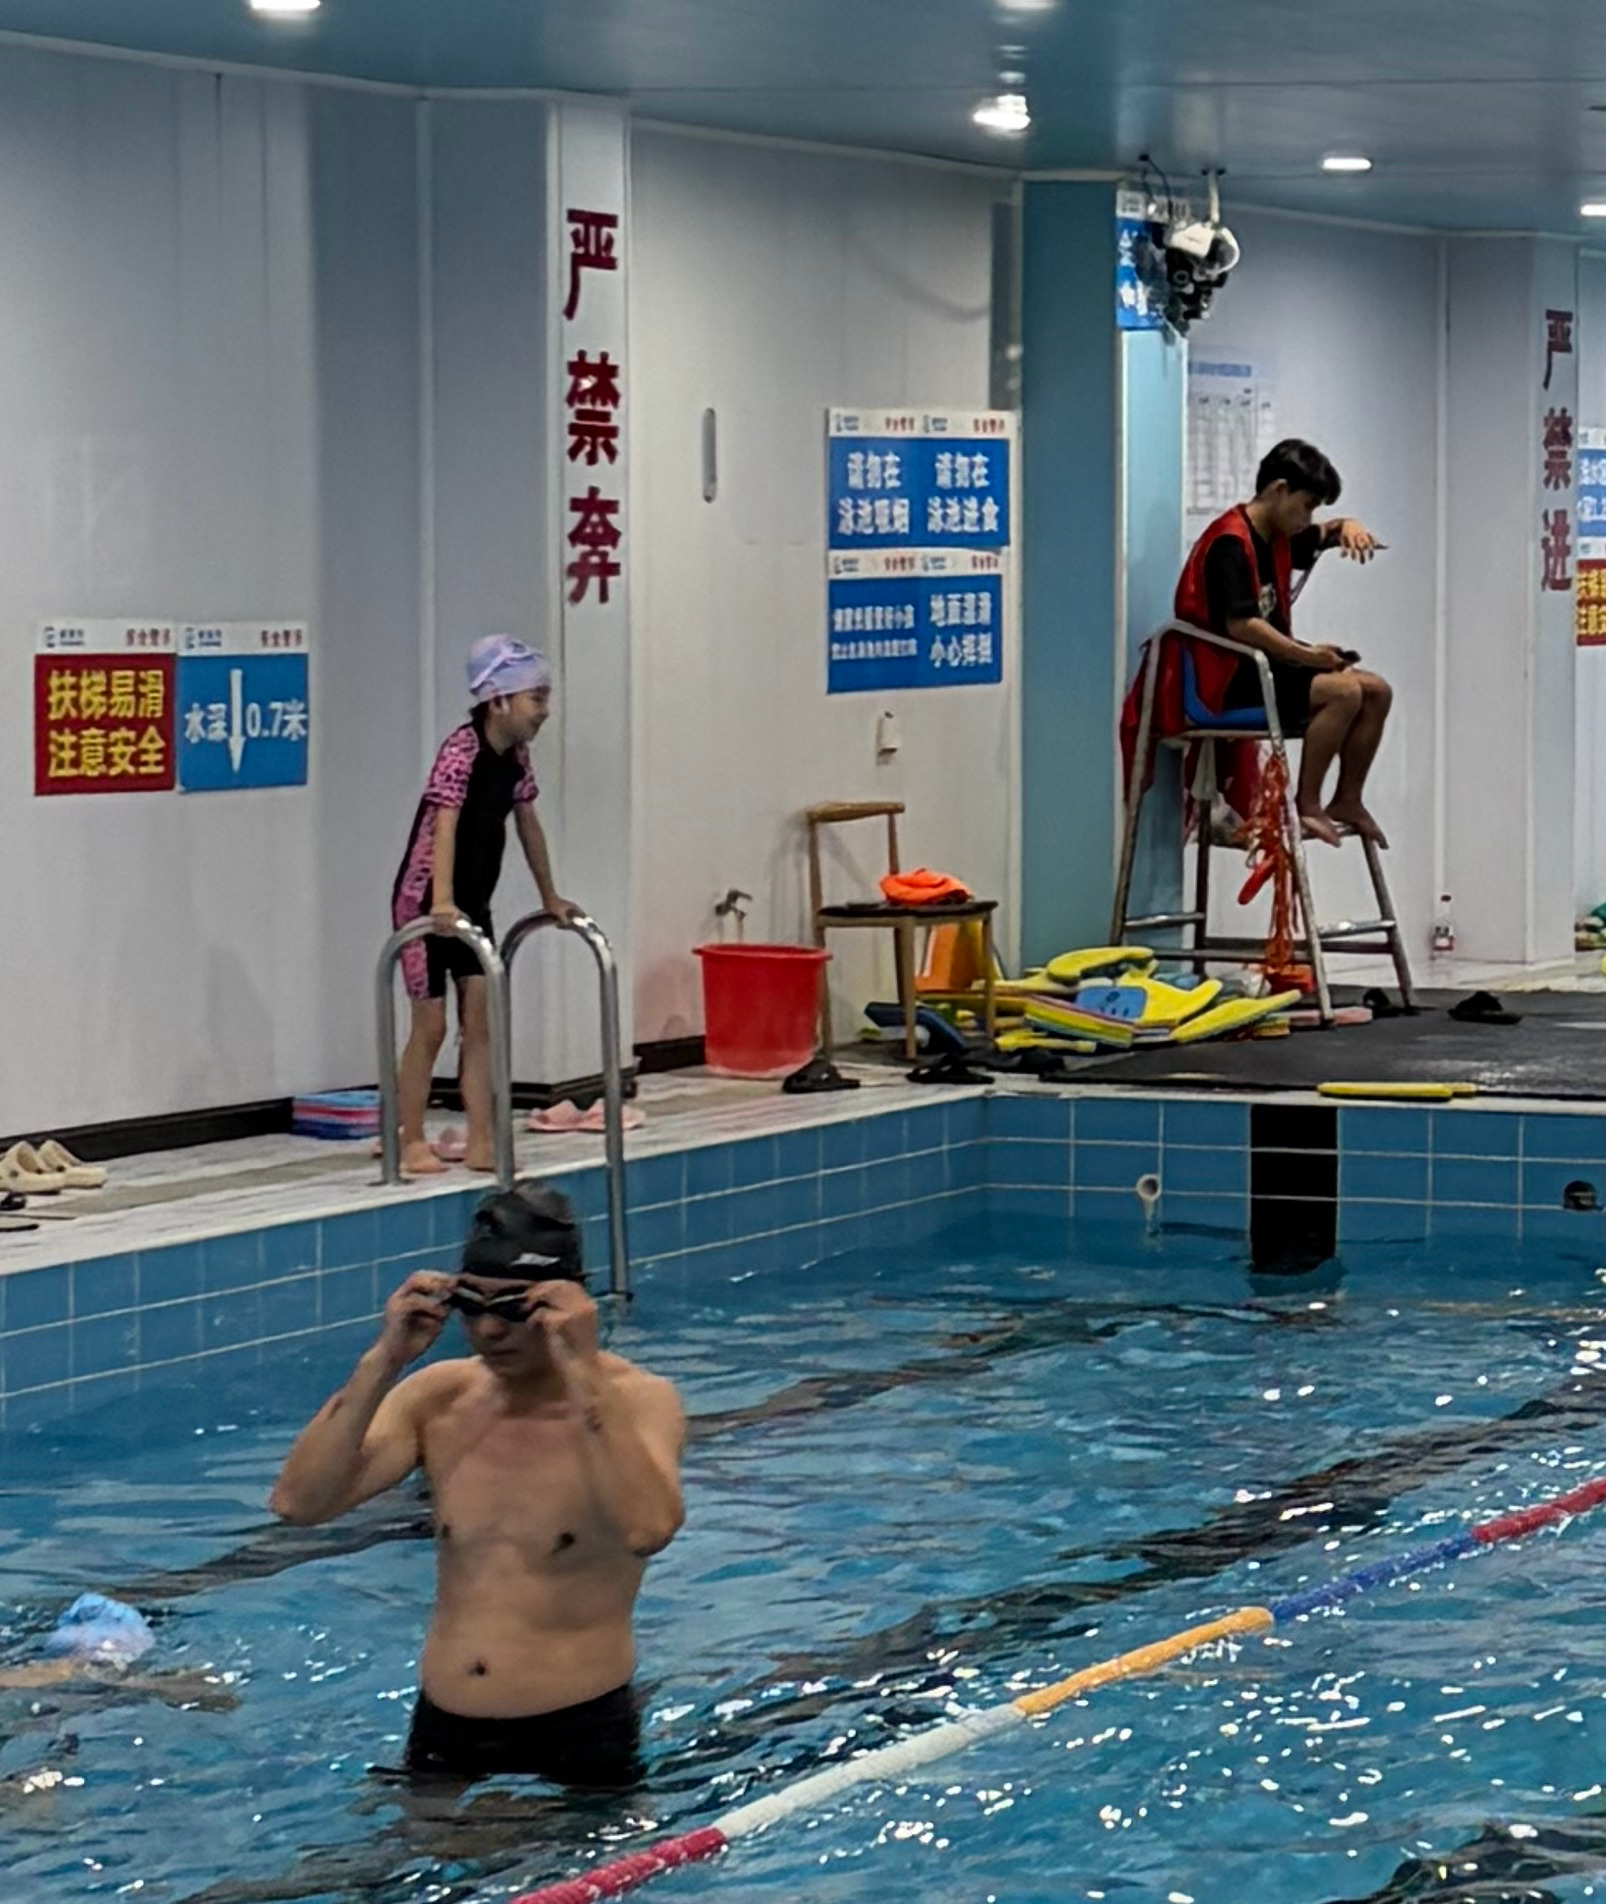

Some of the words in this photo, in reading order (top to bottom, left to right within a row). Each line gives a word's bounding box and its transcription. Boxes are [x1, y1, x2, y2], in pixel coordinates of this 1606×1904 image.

[562, 207, 622, 605] 严禁奔
[47, 668, 165, 721] 扶梯易滑
[184, 701, 228, 744] 水深
[48, 724, 166, 778] 注意安全
